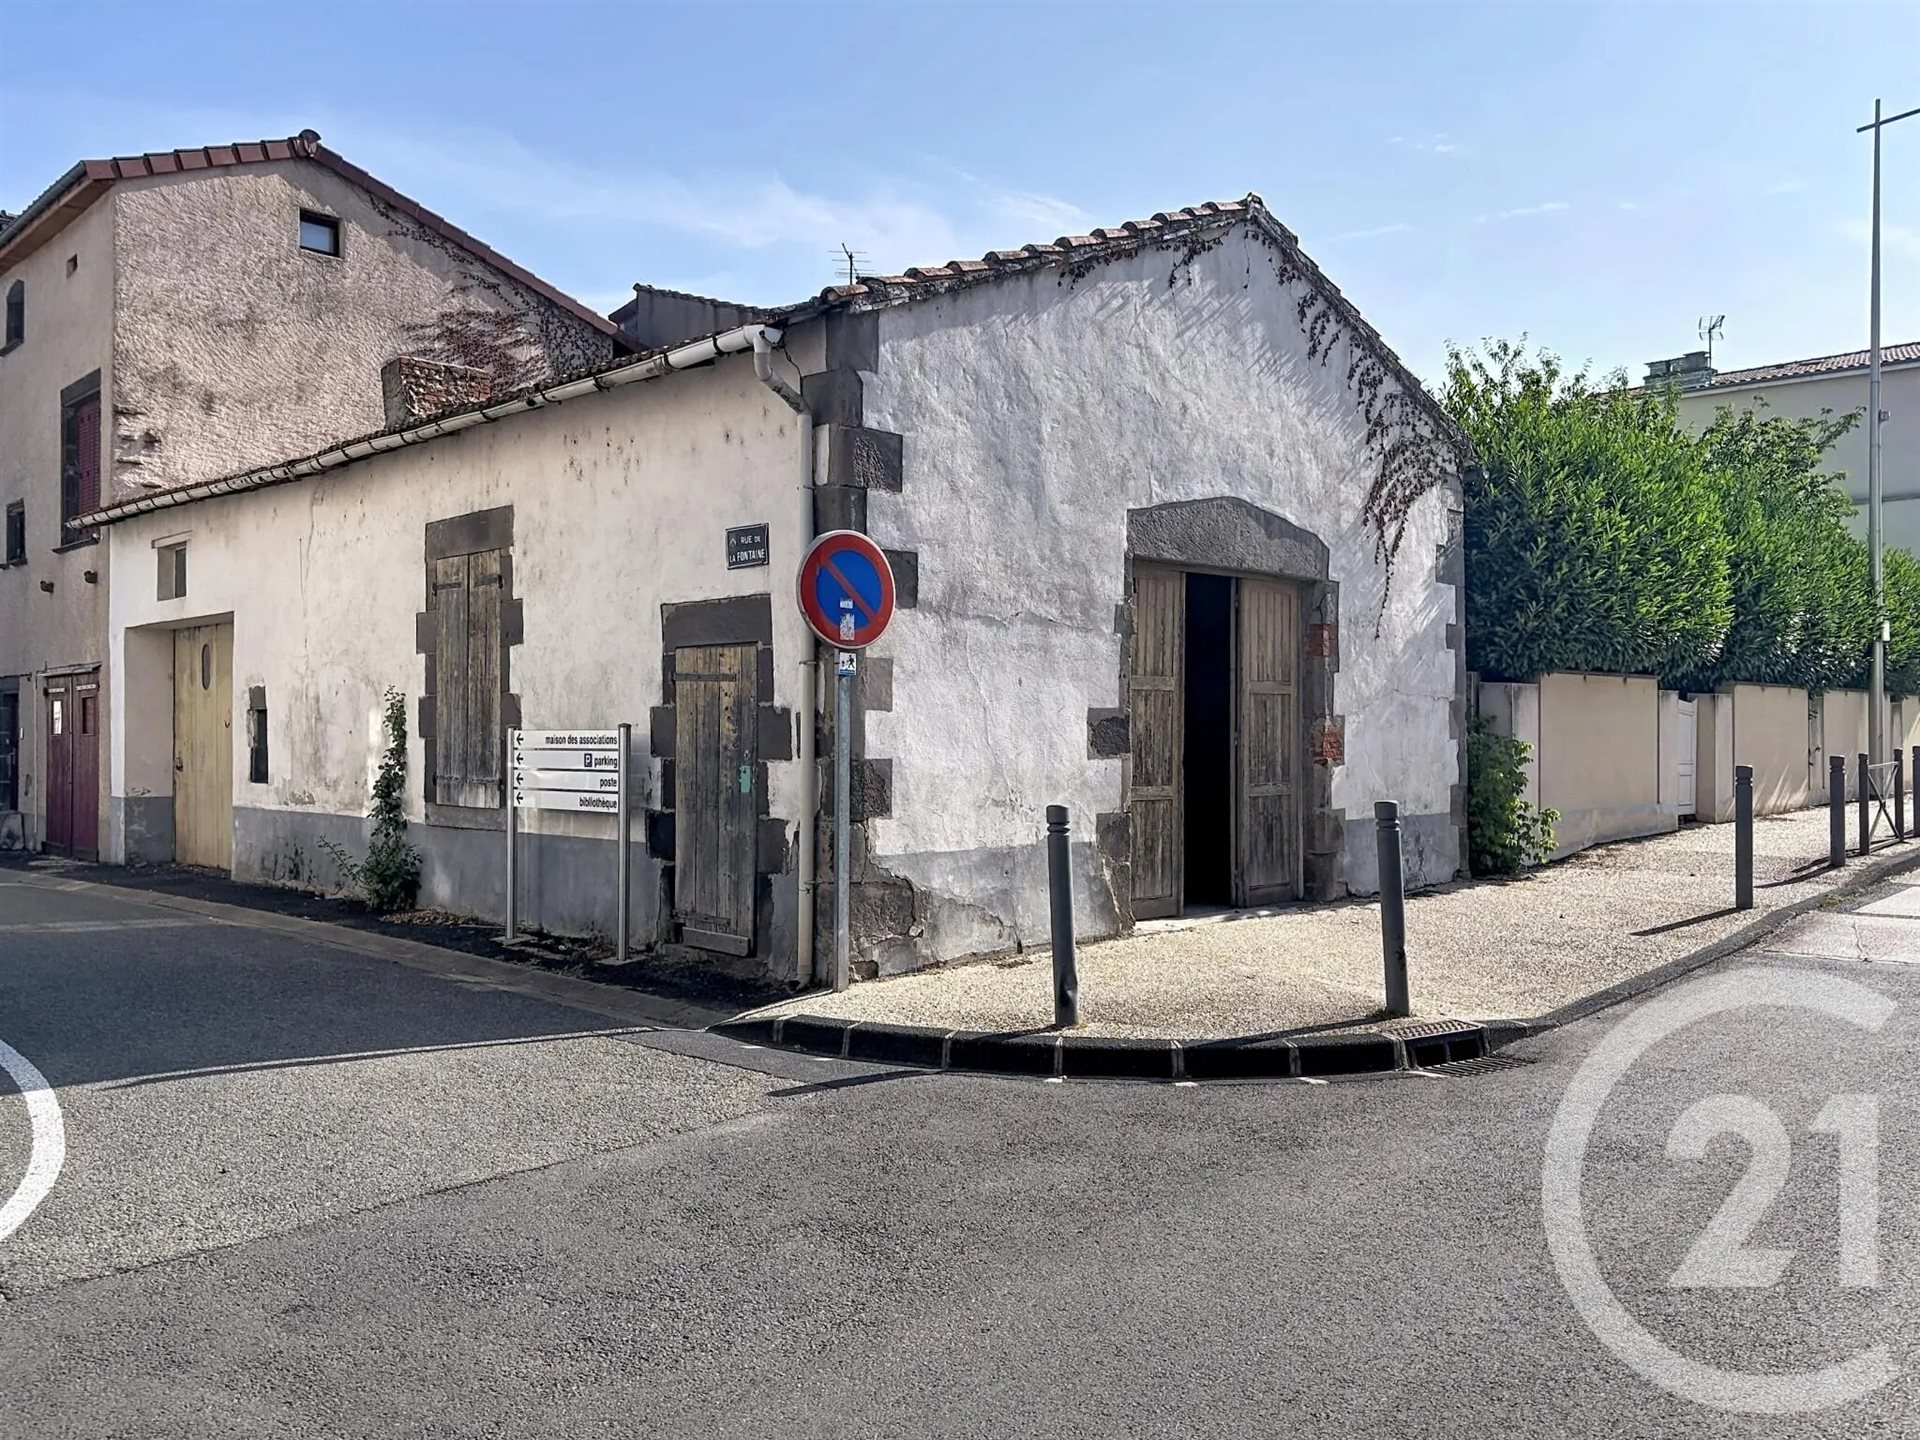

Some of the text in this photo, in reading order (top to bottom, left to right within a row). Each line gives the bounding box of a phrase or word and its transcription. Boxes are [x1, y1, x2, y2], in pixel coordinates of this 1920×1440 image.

[740, 535, 753, 544] RUE
[729, 548, 765, 563] LA FONTAINE
[545, 734, 618, 745] maison des associations
[594, 756, 618, 768] parking
[600, 778, 617, 789] poste
[579, 797, 617, 810] bibliothèque
